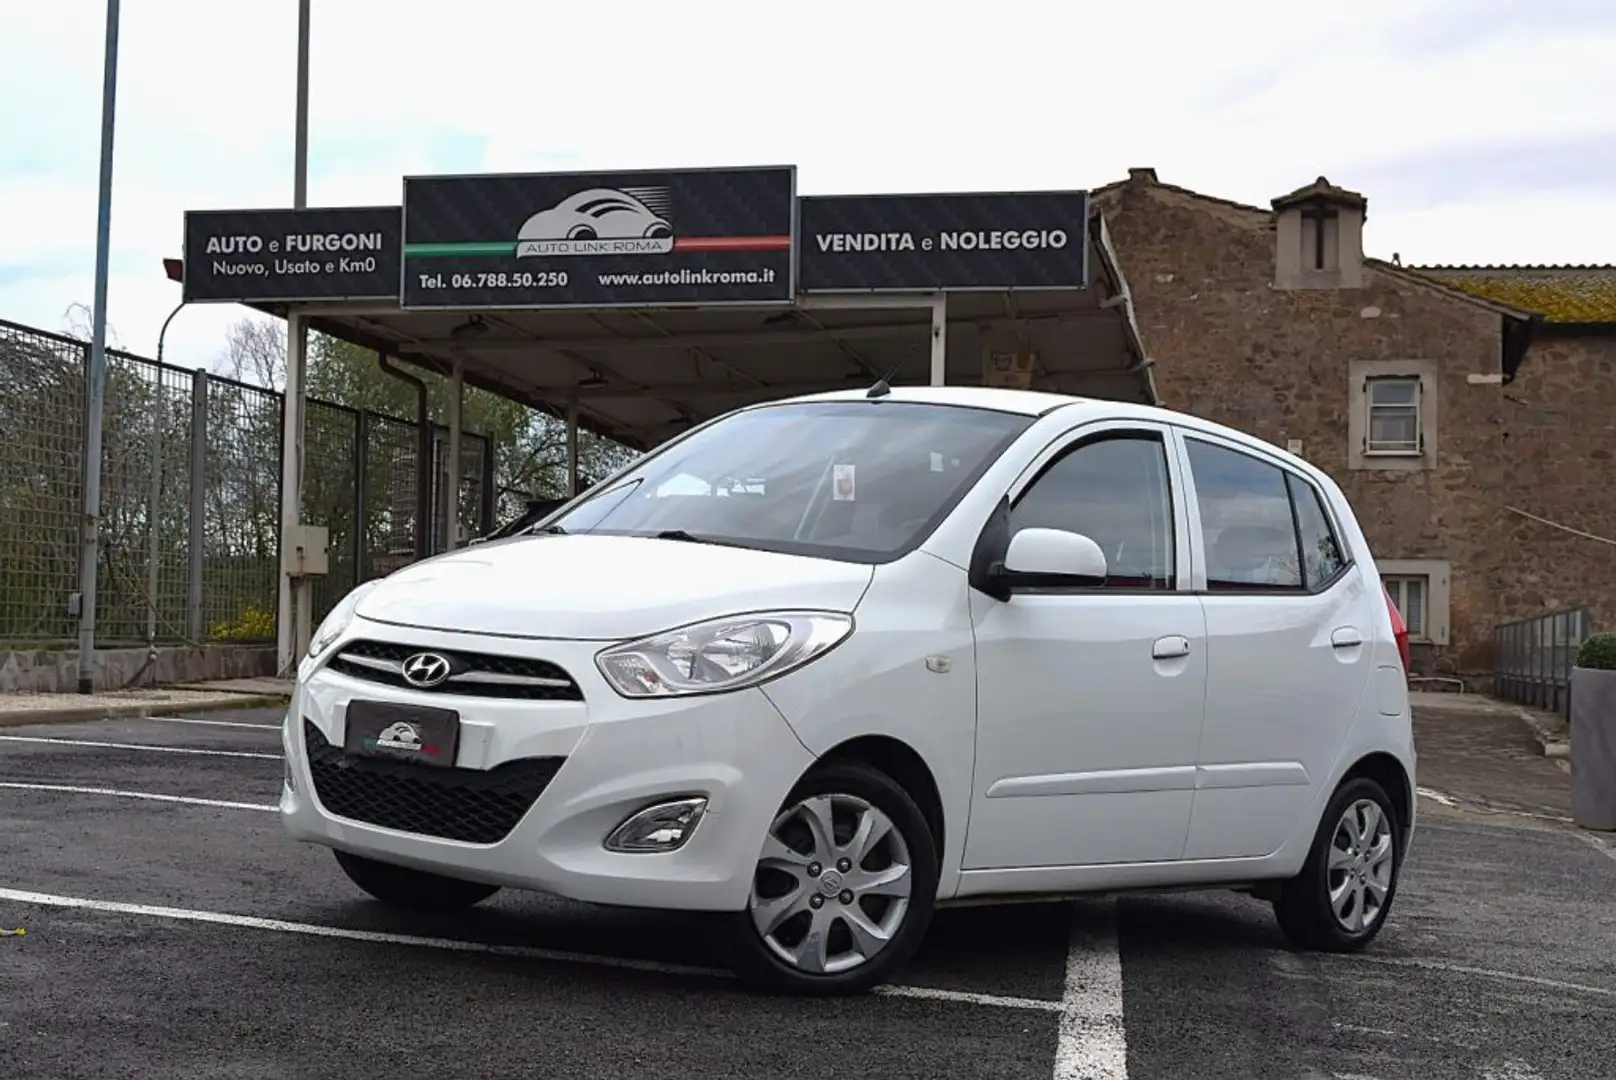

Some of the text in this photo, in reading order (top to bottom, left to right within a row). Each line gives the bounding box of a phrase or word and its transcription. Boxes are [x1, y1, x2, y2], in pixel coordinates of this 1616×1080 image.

[206, 233, 382, 253] AUTO e FURGONI
[526, 241, 663, 253] AUTO LINK ROMA
[816, 230, 1067, 251] VENDITA e NOLEGGIO
[213, 260, 269, 277] Nuovo,
[275, 259, 320, 274] Usato
[325, 262, 335, 273] e
[598, 268, 775, 286] www.autolinkroma.it
[419, 271, 568, 288] Tel. 06.788.50.250
